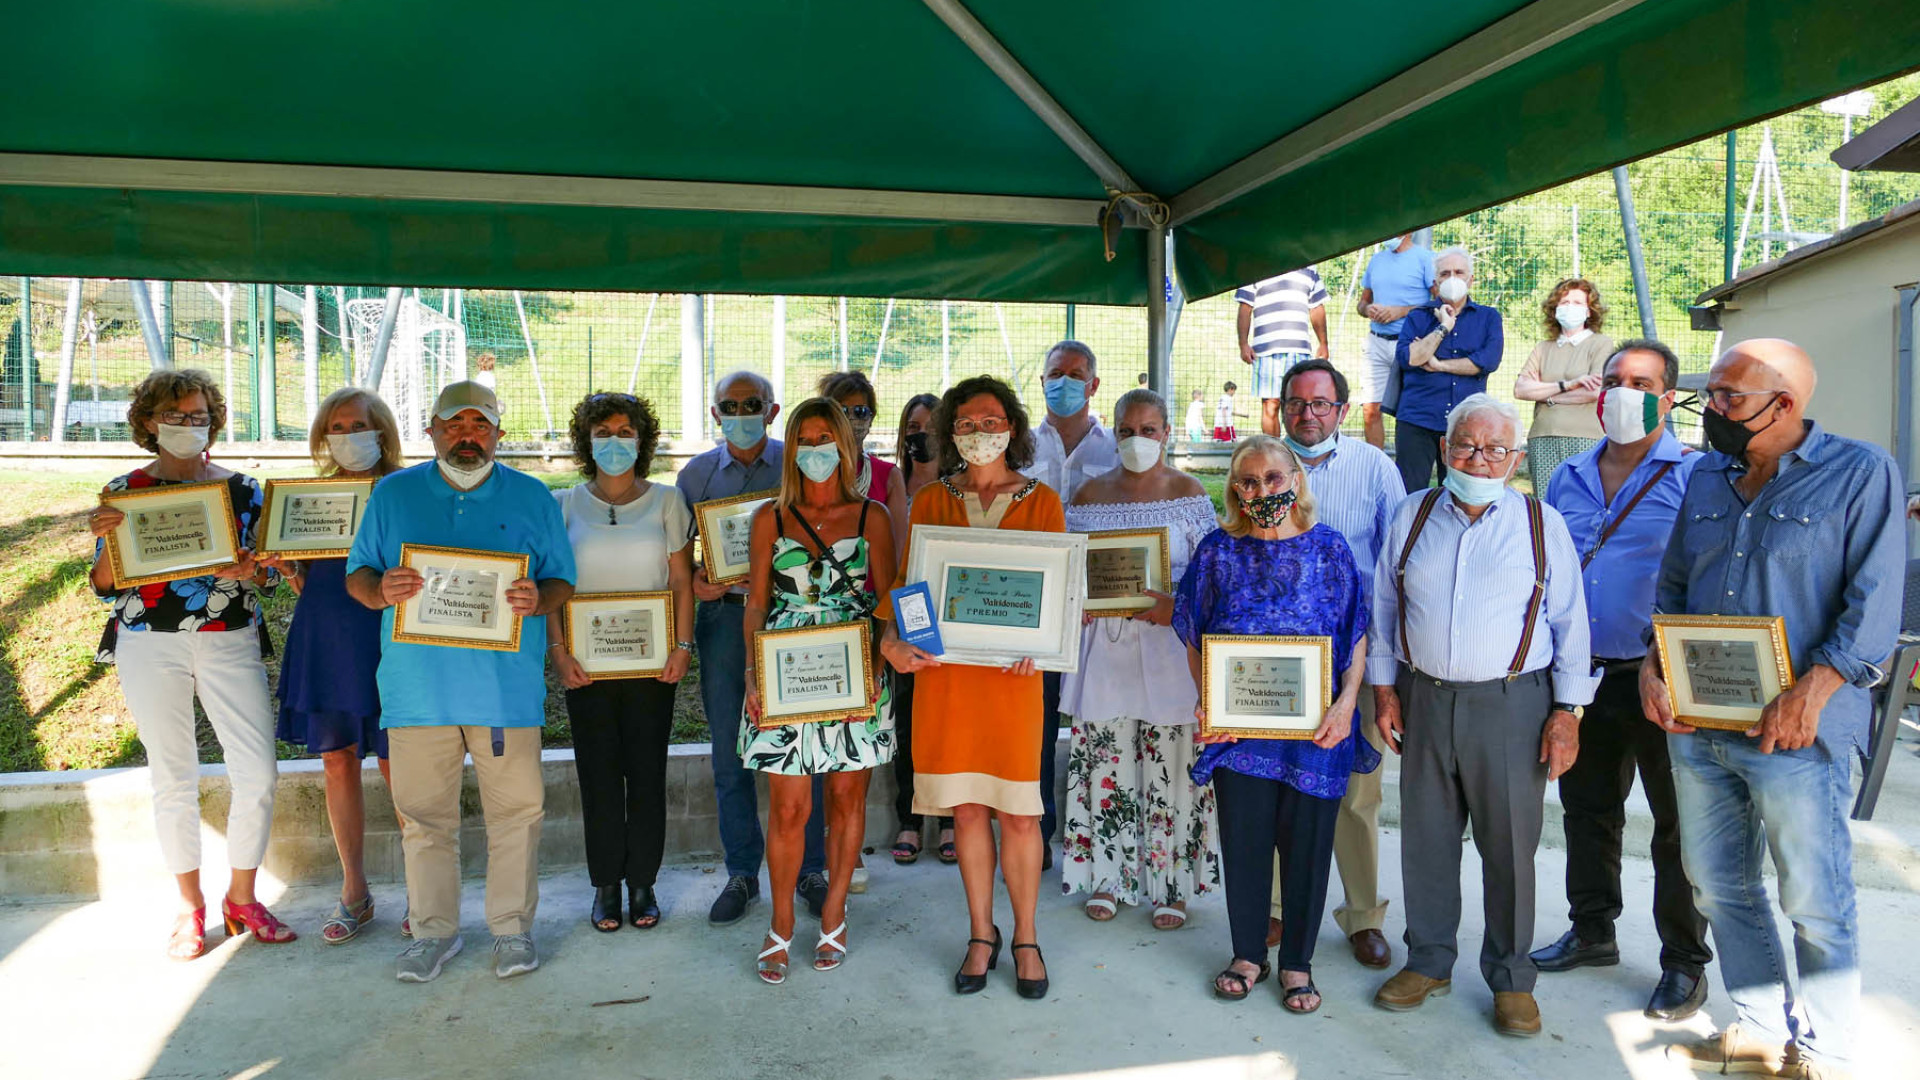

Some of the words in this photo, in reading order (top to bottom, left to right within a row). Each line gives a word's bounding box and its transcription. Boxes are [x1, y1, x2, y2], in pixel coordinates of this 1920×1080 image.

[145, 542, 190, 554] FINALISTA
[429, 607, 473, 618] FINALISTA
[973, 608, 1008, 617] PREMIO
[594, 646, 633, 654] FINALISTA
[787, 684, 828, 694] FINALISTA
[1697, 686, 1742, 696] FINALISTA
[1235, 699, 1280, 707] FINALISTA
